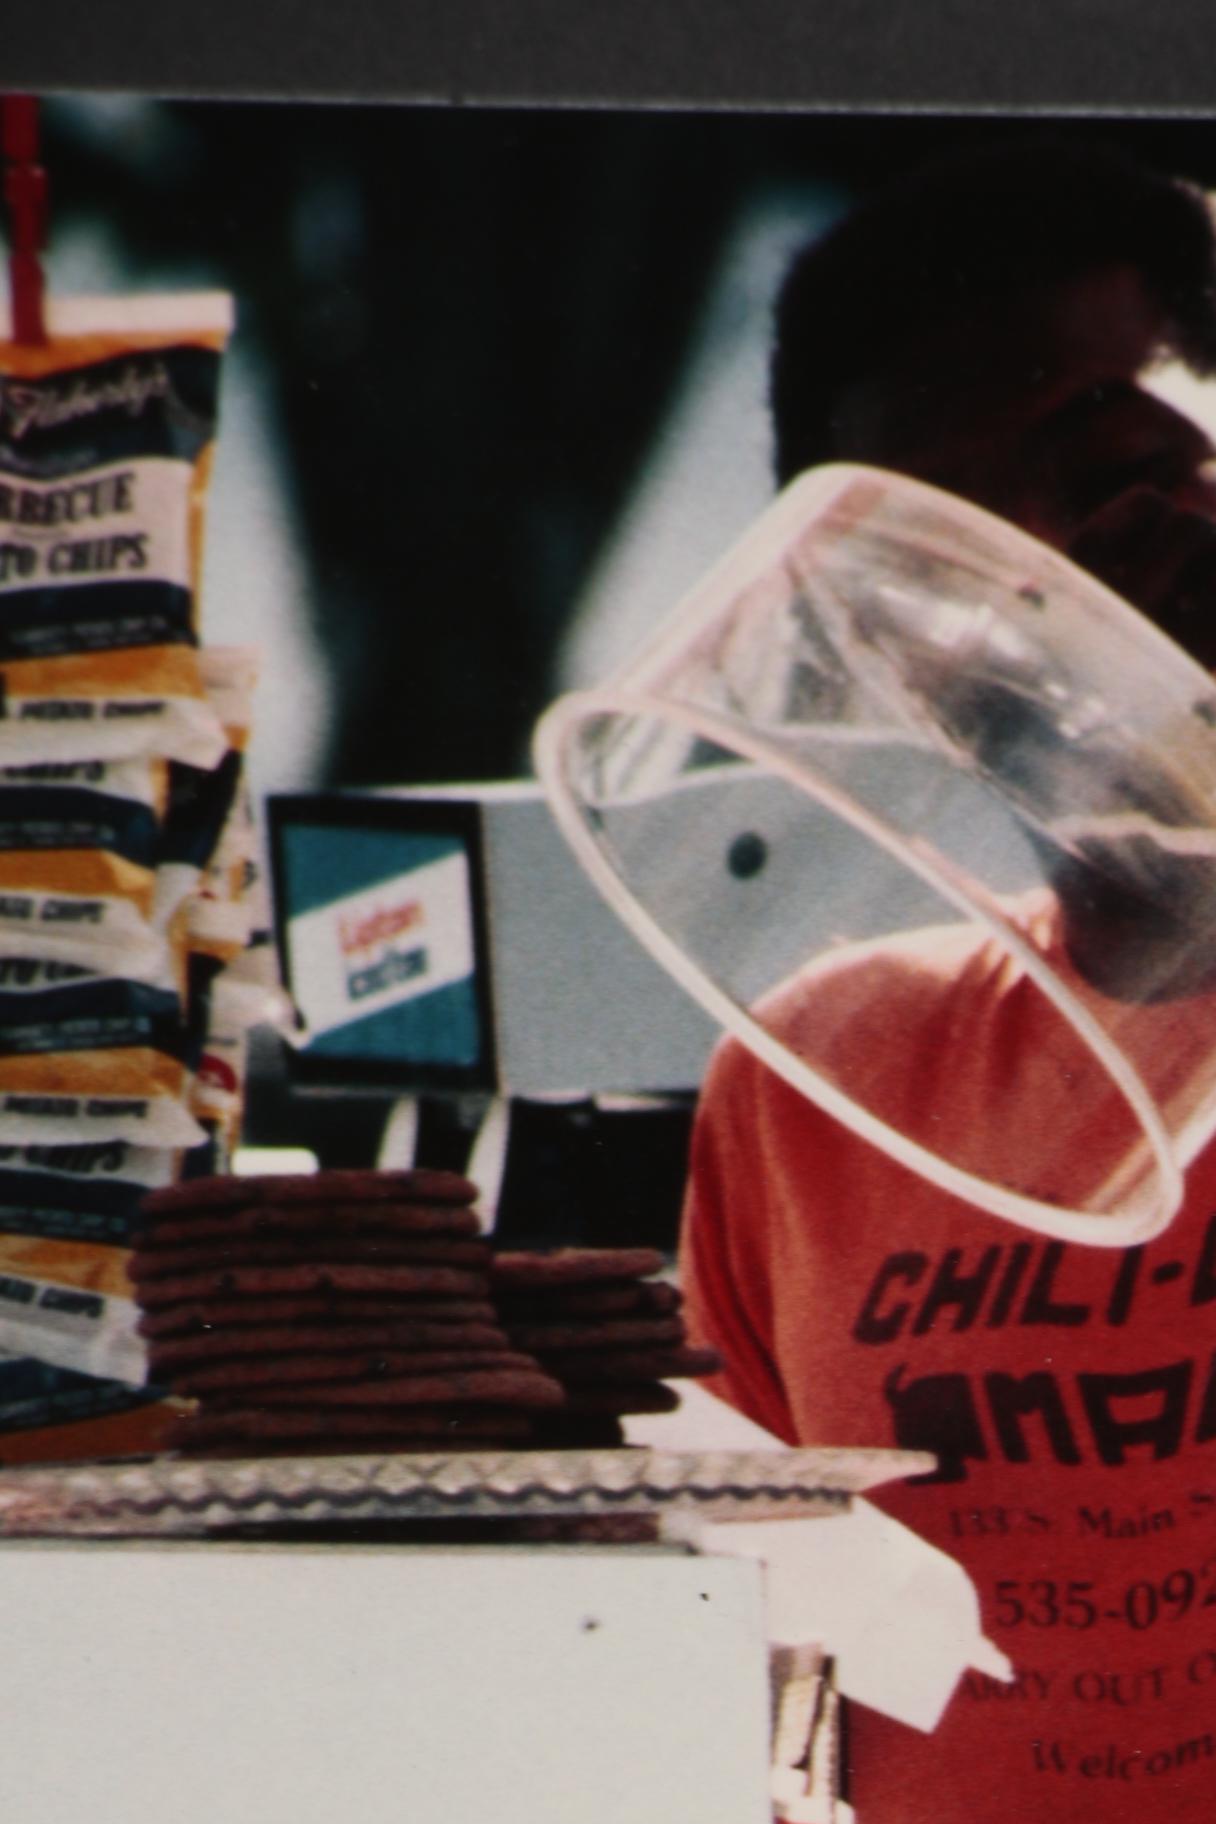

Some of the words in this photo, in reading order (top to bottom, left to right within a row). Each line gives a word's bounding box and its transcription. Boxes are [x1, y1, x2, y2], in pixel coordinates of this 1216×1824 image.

[47, 532, 149, 575] CHIPS
[1077, 1504, 1177, 1539] Main
[1073, 1667, 1173, 1707] OUT
